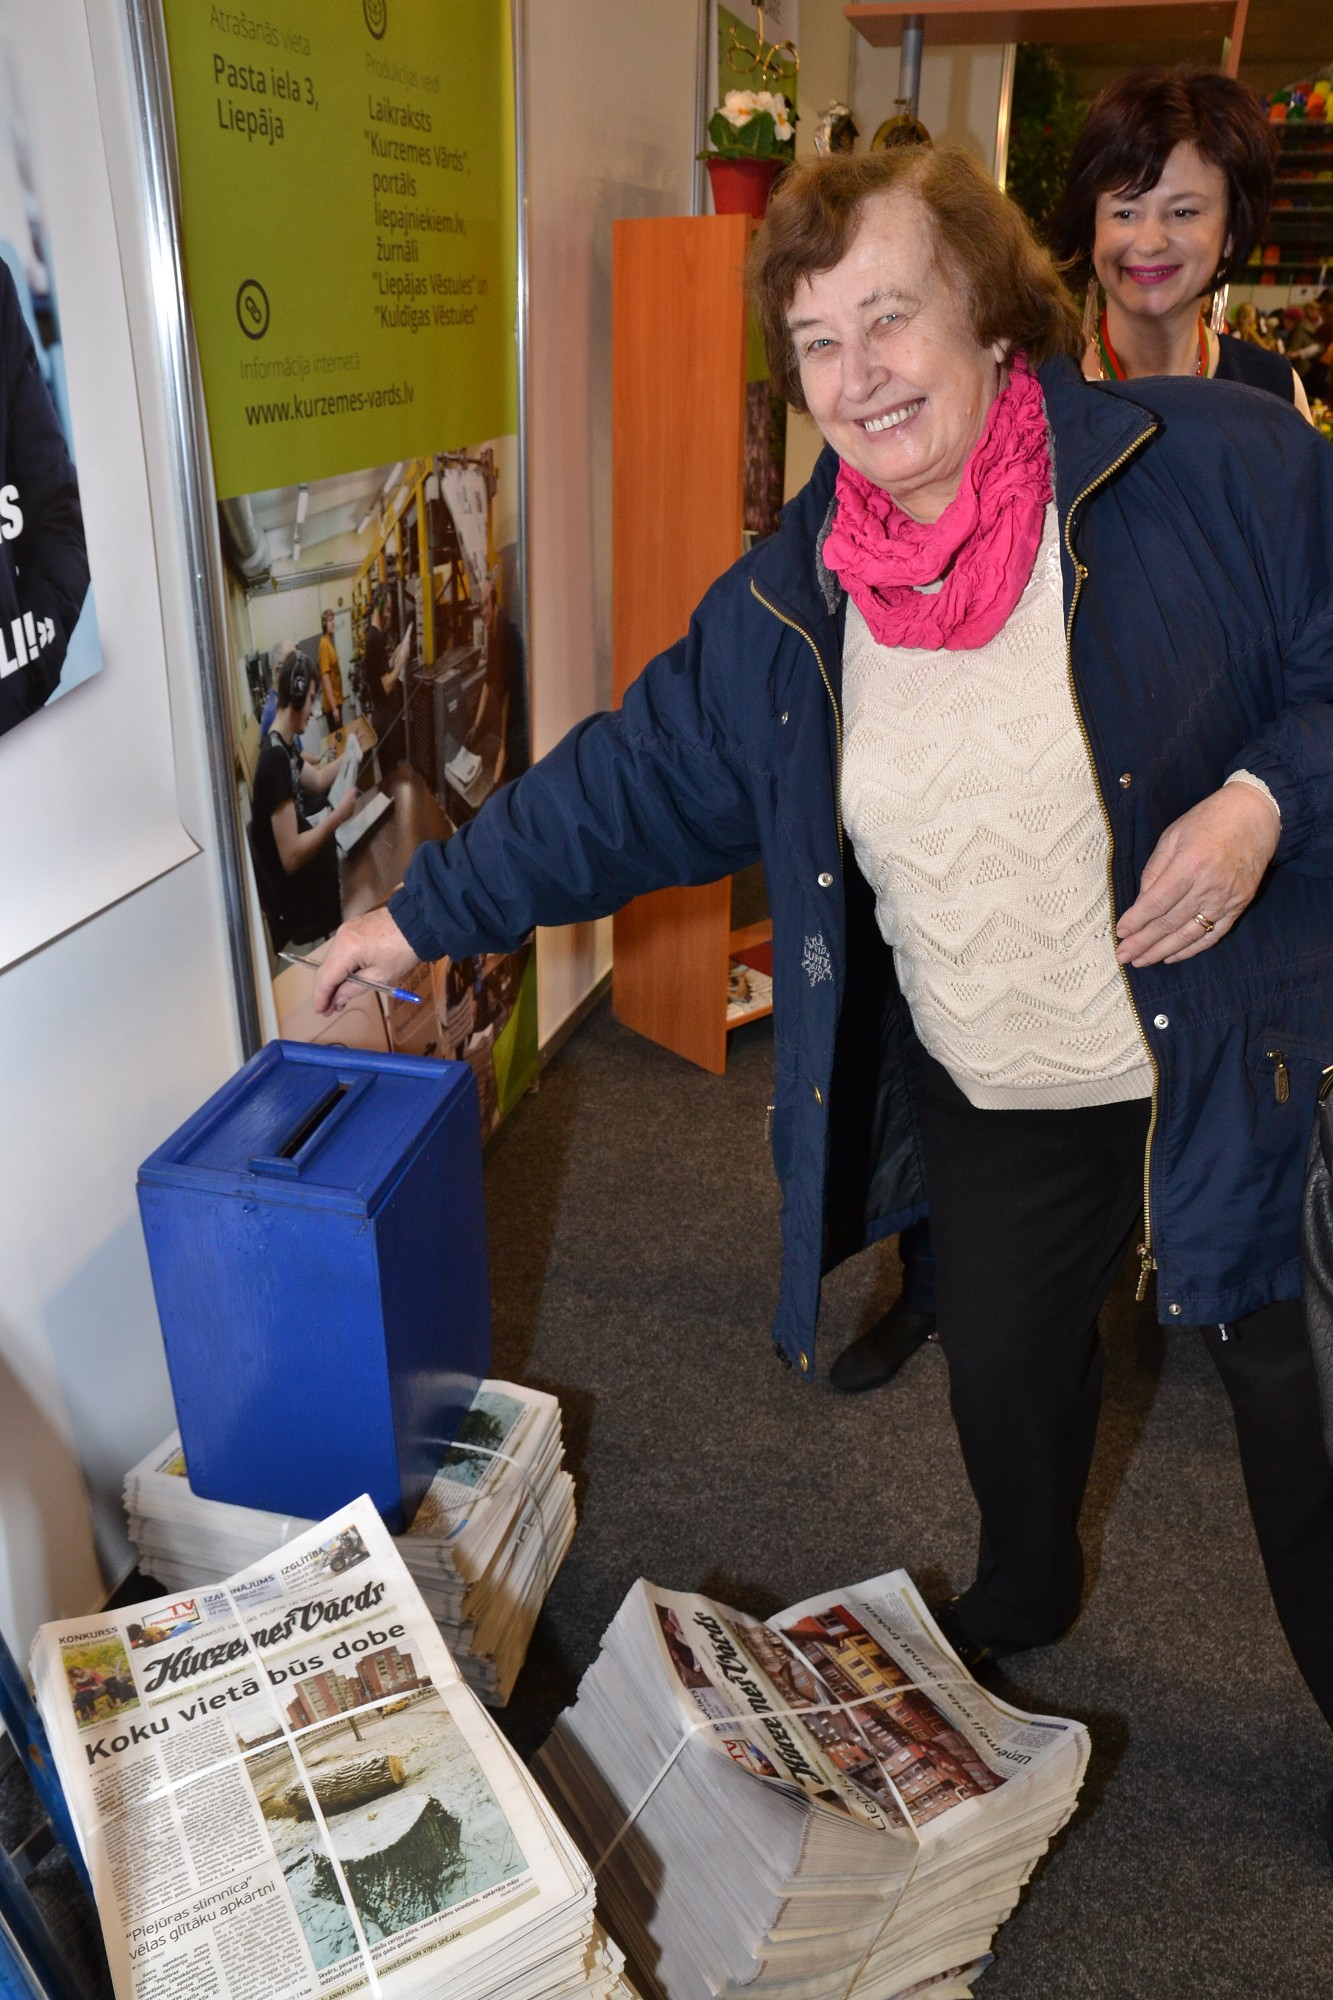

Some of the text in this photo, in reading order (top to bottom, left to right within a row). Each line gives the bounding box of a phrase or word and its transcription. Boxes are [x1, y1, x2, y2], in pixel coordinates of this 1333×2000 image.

[210, 4, 280, 47] Atrašanās
[213, 53, 319, 111] Pasta iela 3,
[217, 98, 284, 146] Liepāja
[368, 94, 432, 133] Laikraksts
[373, 171, 417, 198] portāls
[376, 238, 419, 263] žurnāli
[240, 352, 361, 382] Informācija internetā
[245, 381, 415, 426] www.kurzemes-vards.lv
[279, 1546, 326, 1577] IZGLĪTĪBA
[166, 1598, 196, 1618] TV
[860, 1602, 901, 1641] troksni
[58, 1625, 119, 1645] KONKURSS
[143, 1609, 299, 1694] Kurzemes
[291, 1580, 385, 1633] Vārds
[692, 1611, 748, 1685] Vārds
[84, 1712, 171, 1765] Koku
[177, 1676, 261, 1723] vietā
[267, 1653, 325, 1687] būs
[331, 1622, 406, 1661] dobe
[947, 1693, 974, 1718] sola
[722, 1739, 745, 1762] TV
[125, 1875, 252, 1942] “Piejūras slimnīca”
[128, 1880, 276, 1960] vēlas glītāku apkārtni
